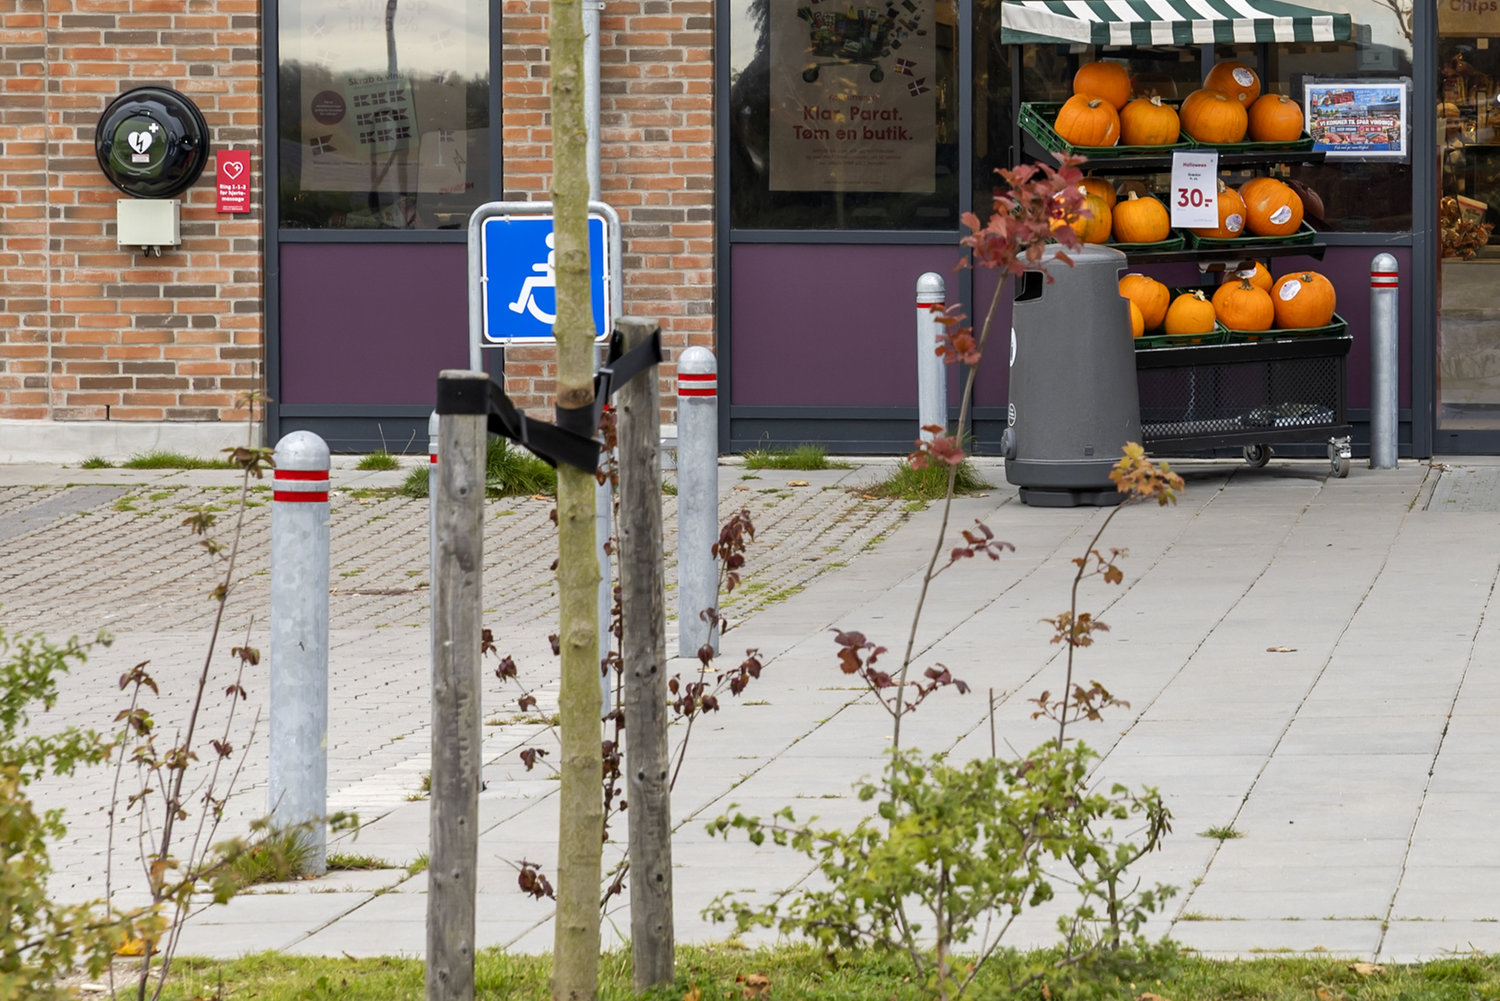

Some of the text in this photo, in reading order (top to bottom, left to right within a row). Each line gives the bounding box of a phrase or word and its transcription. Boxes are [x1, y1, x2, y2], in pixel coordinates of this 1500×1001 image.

[405, 0, 429, 15] op
[348, 75, 374, 86] Skrab
[850, 106, 903, 121] Parat.
[793, 125, 914, 140] Tøm en butik.
